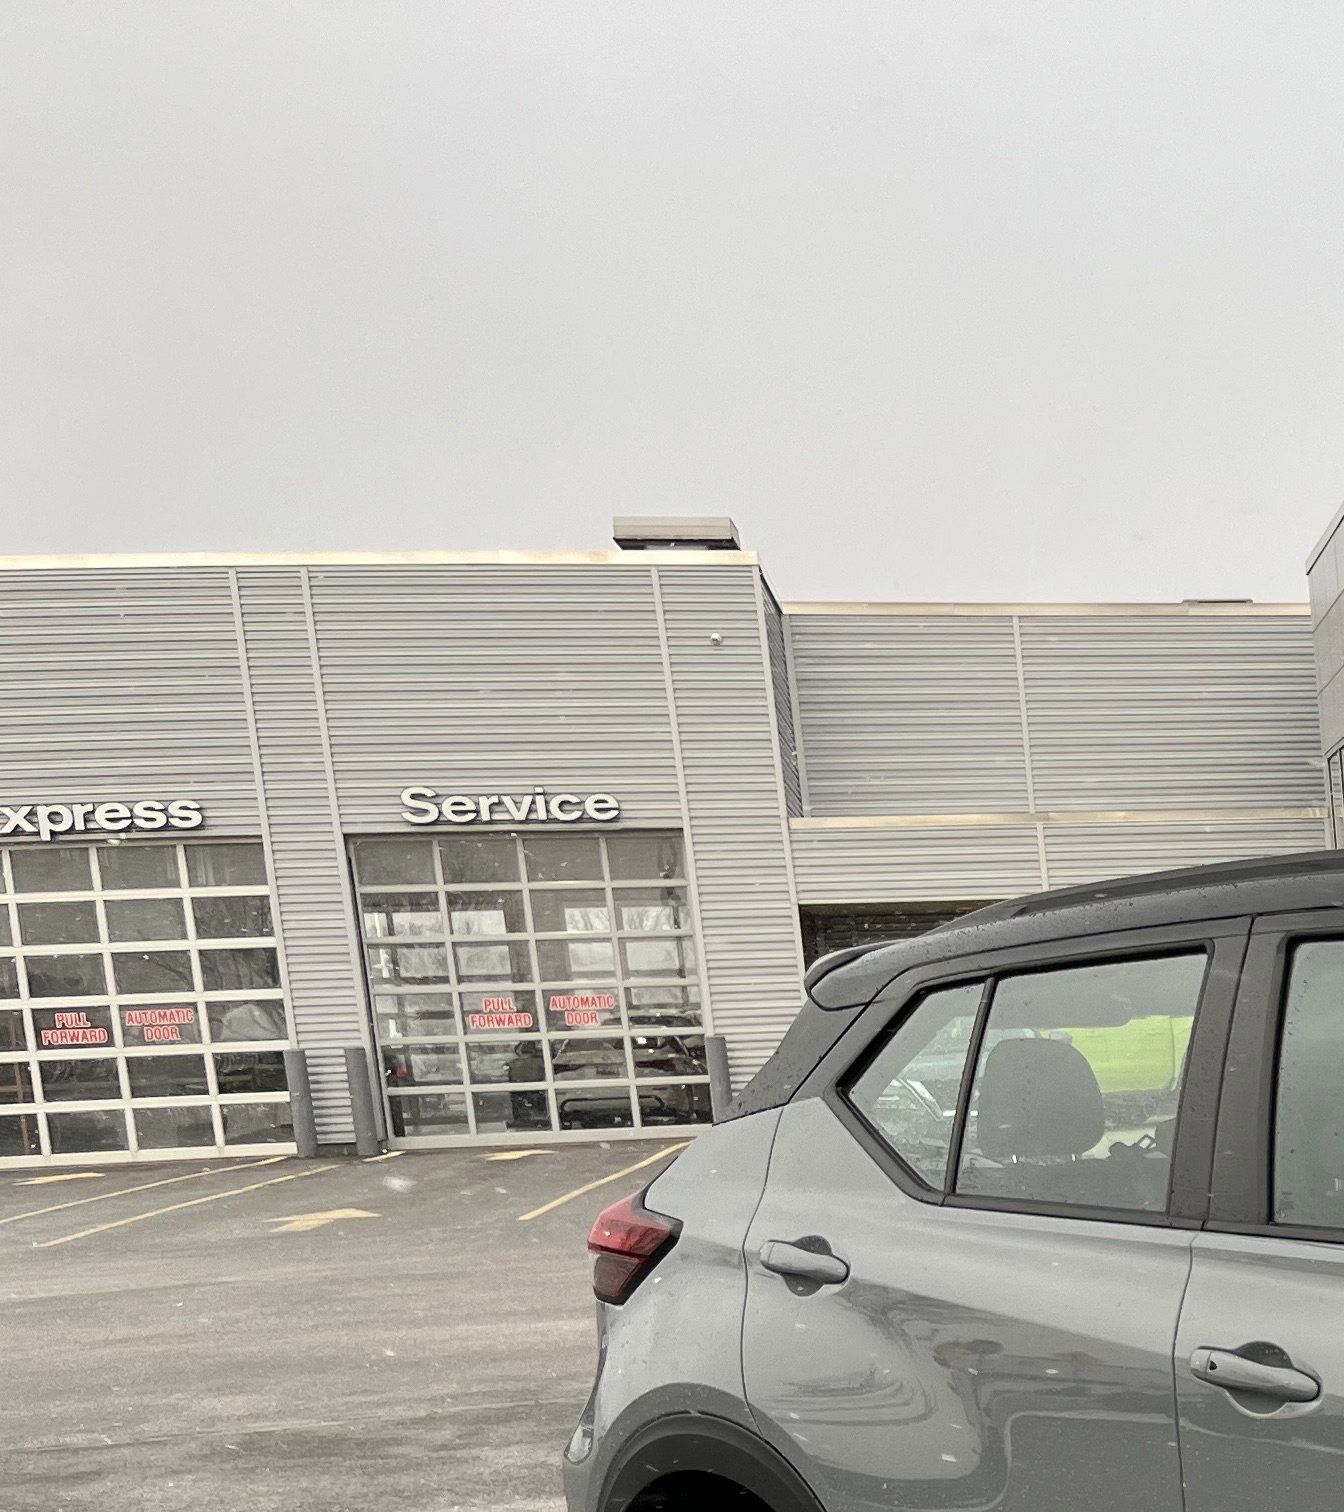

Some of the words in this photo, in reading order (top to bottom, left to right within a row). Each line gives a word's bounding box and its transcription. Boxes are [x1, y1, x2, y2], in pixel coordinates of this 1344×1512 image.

[400, 785, 621, 825] Service
[482, 997, 517, 1013] PULL
[549, 994, 615, 1011] AUTOMATIC
[54, 1012, 91, 1029] PULL
[125, 1007, 196, 1026] AUTOMATIC
[468, 1012, 534, 1029] FORWARD
[564, 1010, 599, 1027] DOOR
[40, 1028, 109, 1046] FORWARD
[143, 1025, 182, 1042] DOOR
